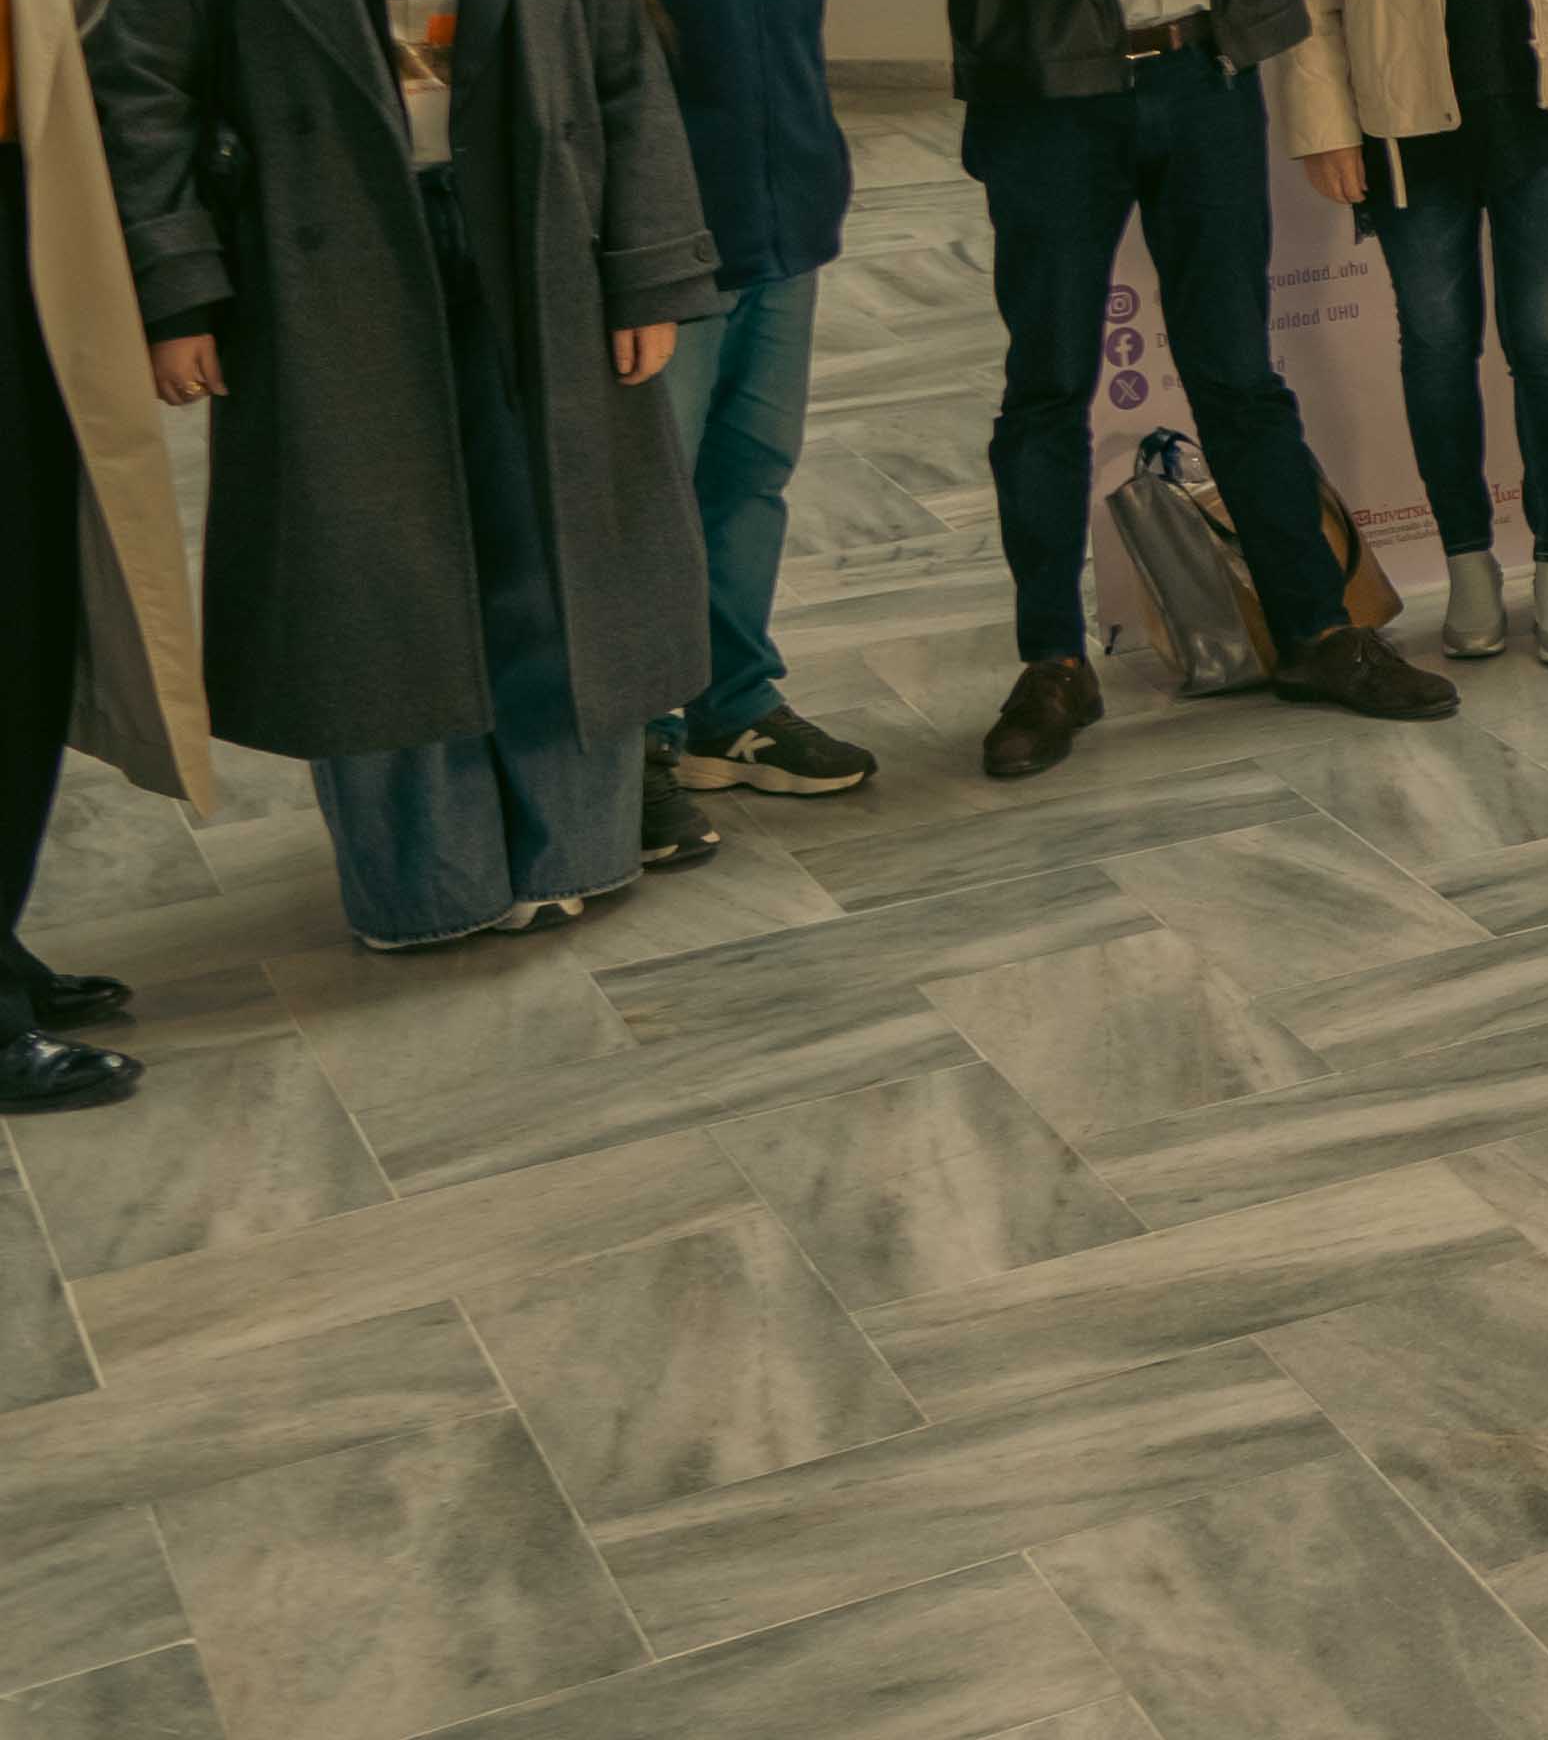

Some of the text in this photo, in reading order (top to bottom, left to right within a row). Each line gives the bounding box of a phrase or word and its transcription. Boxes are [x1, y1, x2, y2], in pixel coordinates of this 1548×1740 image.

[1269, 260, 1368, 291] ualdad_uhu
[1269, 304, 1360, 332] aldad UHU
